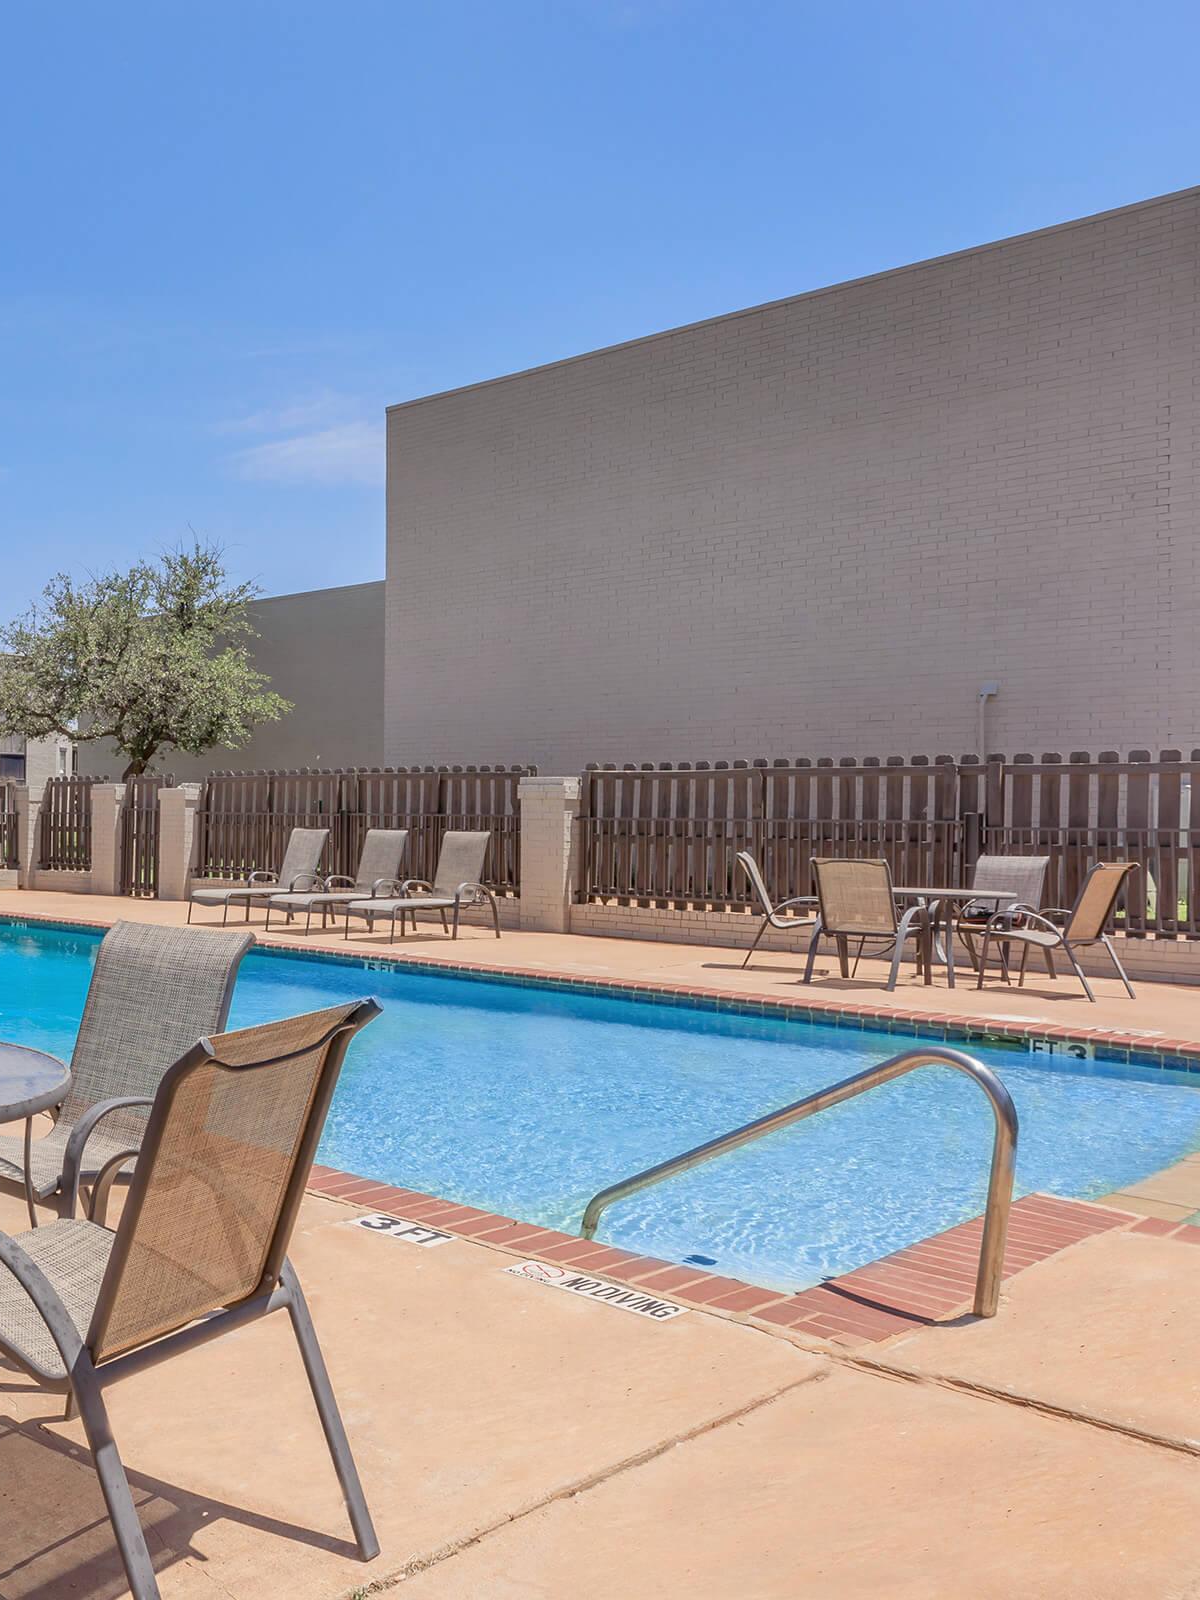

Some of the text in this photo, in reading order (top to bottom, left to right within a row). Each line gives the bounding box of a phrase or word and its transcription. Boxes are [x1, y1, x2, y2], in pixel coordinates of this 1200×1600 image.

[1032, 1040, 1058, 1055] FT
[360, 1217, 453, 1244] 3 FT
[560, 1277, 680, 1318] NO DIVING
